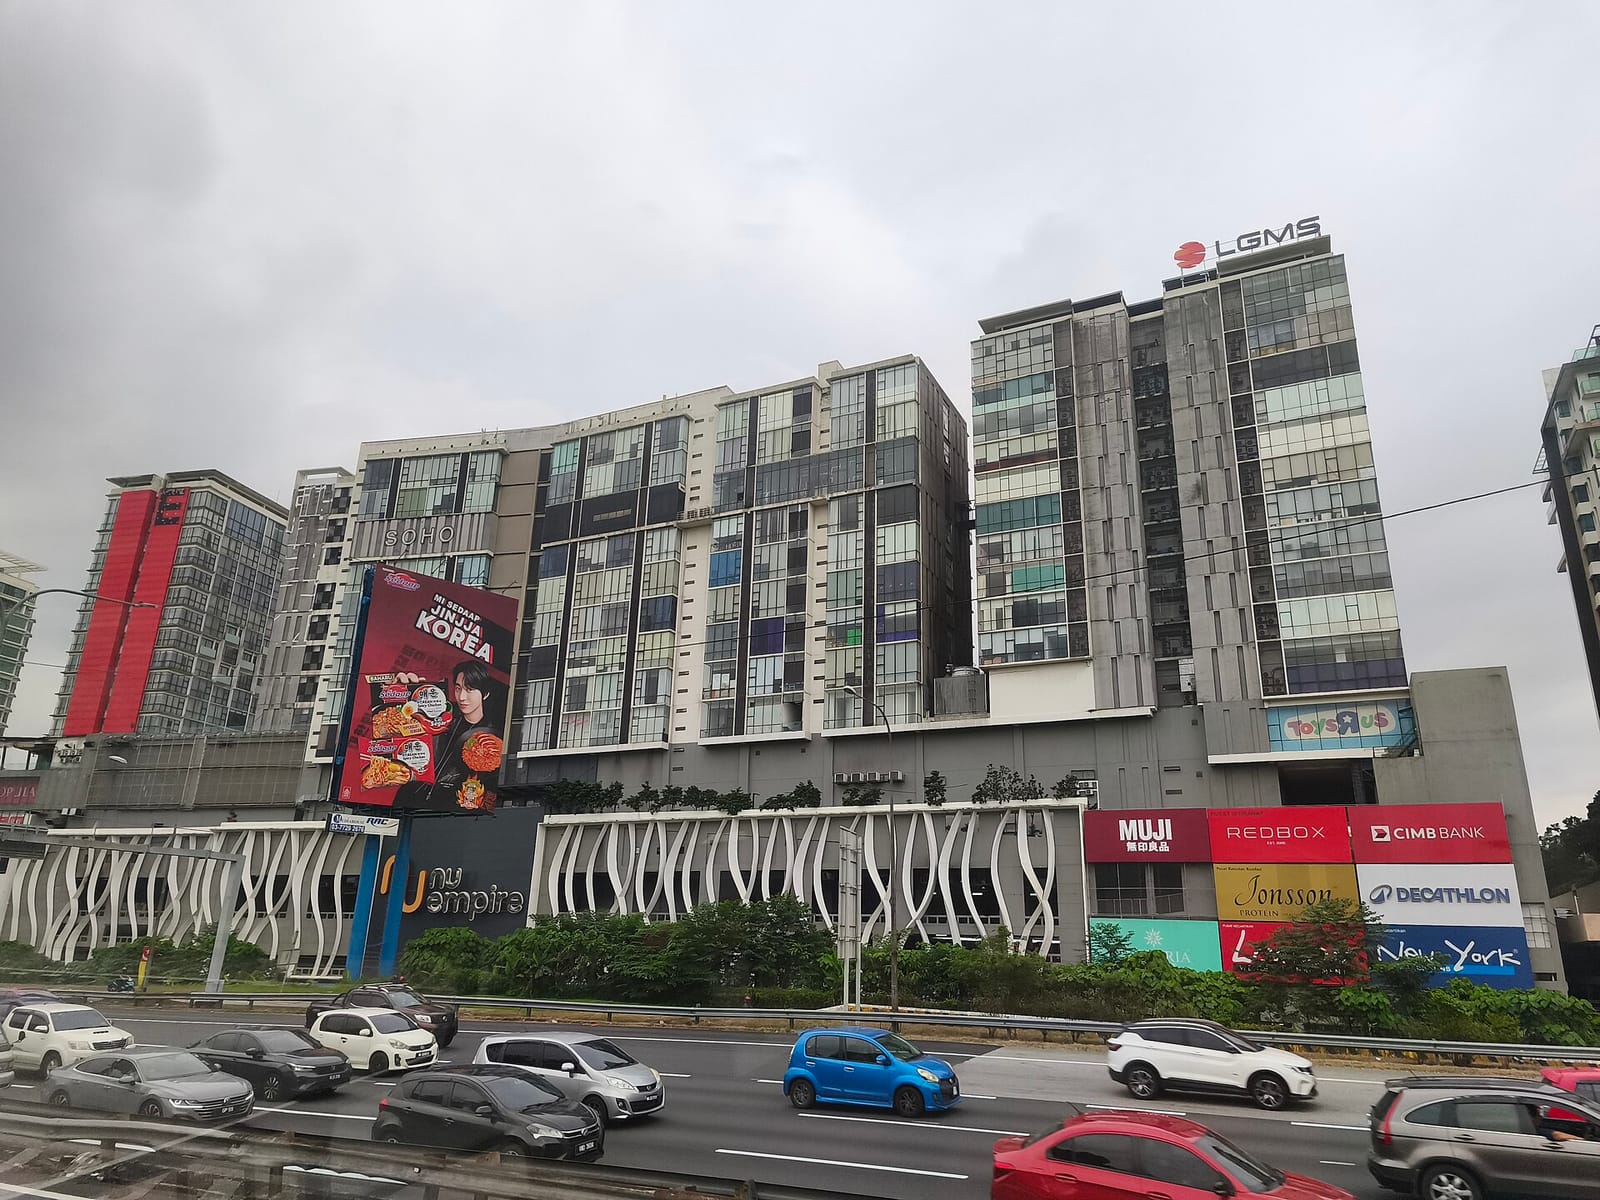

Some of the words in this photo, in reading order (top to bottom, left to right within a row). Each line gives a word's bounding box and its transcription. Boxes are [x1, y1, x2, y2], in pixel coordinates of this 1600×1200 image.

[1215, 215, 1321, 257] LGMS
[385, 526, 454, 546] SOHO
[433, 594, 446, 605] MI
[446, 601, 481, 621] SEDAAP
[430, 605, 482, 637] JINJJA
[415, 610, 492, 663] KOREA
[1118, 818, 1173, 841] MUJI
[1226, 826, 1325, 839] REDBOX
[1393, 827, 1437, 840] CIMB
[1439, 826, 1486, 839] BANK
[1127, 841, 1170, 852] 無印良品
[426, 884, 524, 921] empire
[1234, 874, 1332, 906] Jonsson
[1396, 887, 1511, 904] DECATHLON
[1239, 909, 1279, 917] PROTEIN
[1444, 939, 1521, 972] York
